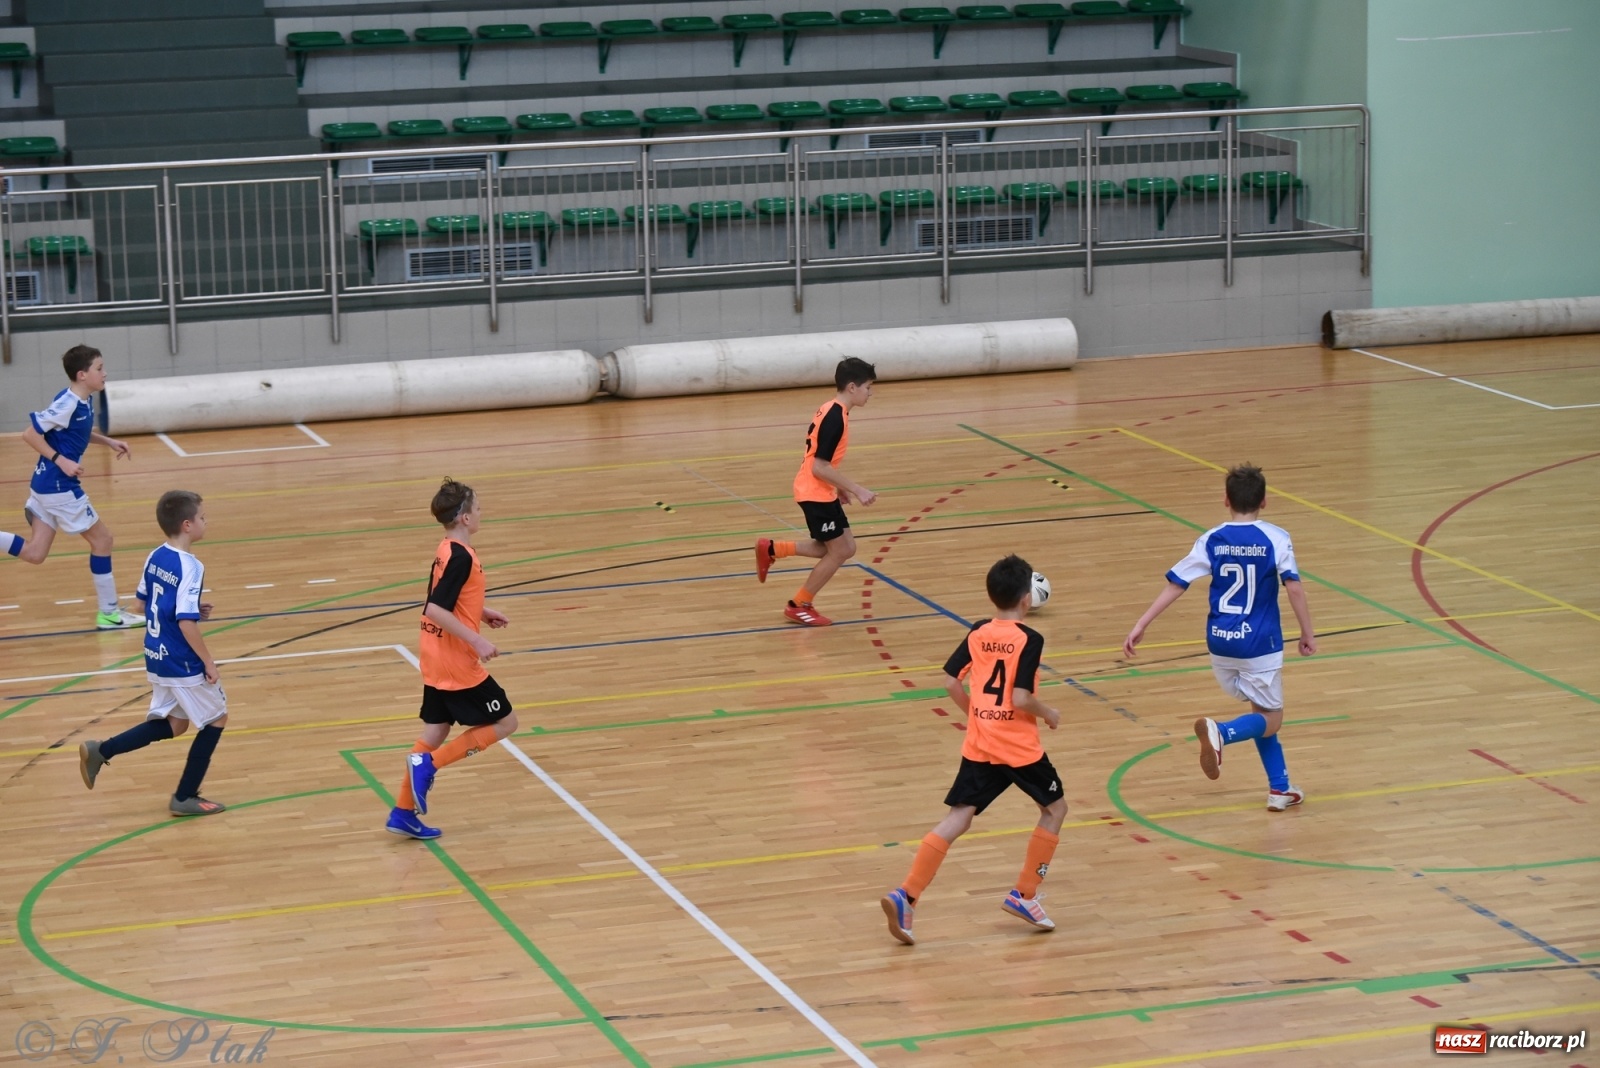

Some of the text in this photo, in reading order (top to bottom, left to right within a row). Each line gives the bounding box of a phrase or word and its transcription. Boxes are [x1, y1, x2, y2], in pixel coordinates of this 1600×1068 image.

[86, 505, 94, 518] 4
[821, 521, 836, 533] 44
[1230, 543, 1267, 557] RACIBÓRZ
[1218, 563, 1256, 615] 21
[147, 581, 164, 638] 5
[981, 642, 1015, 654] RAFAKO
[983, 658, 1006, 706] 4
[486, 699, 501, 713] 10
[1049, 780, 1058, 792] 4
